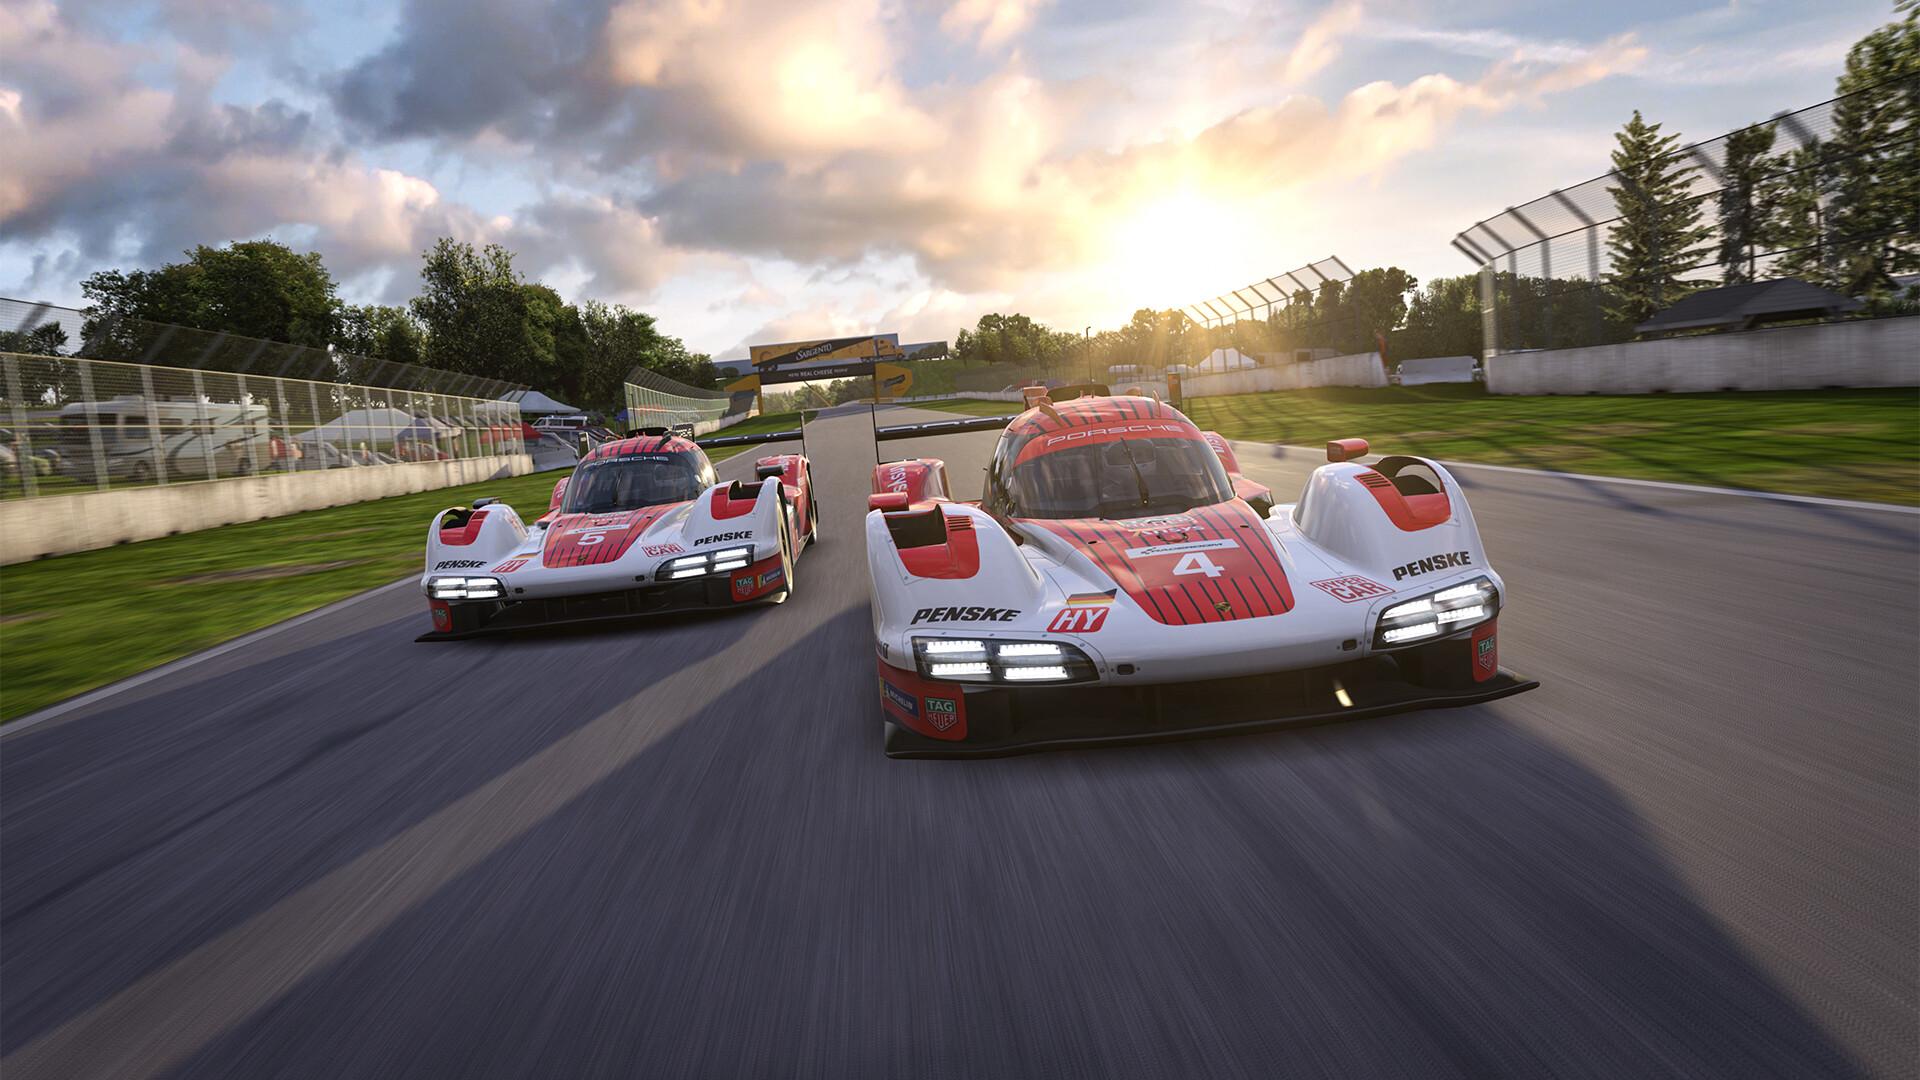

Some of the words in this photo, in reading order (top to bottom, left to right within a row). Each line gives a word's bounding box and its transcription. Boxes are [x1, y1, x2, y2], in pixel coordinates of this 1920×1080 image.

[795, 343, 833, 360] SARGENTO
[1047, 425, 1184, 446] PORSCHE
[577, 531, 607, 546] 5
[693, 531, 753, 547] PENSKE
[648, 545, 681, 556] CAR
[434, 560, 488, 571] PENSKE
[1172, 552, 1225, 578] 4
[1392, 551, 1472, 581] PENSKE
[1316, 576, 1365, 589] HYPER
[1330, 583, 1390, 601] CAR
[911, 606, 1021, 625] PENSKE
[1053, 608, 1106, 631] HY
[927, 699, 953, 712] TAG
[928, 713, 955, 729] HEUER
